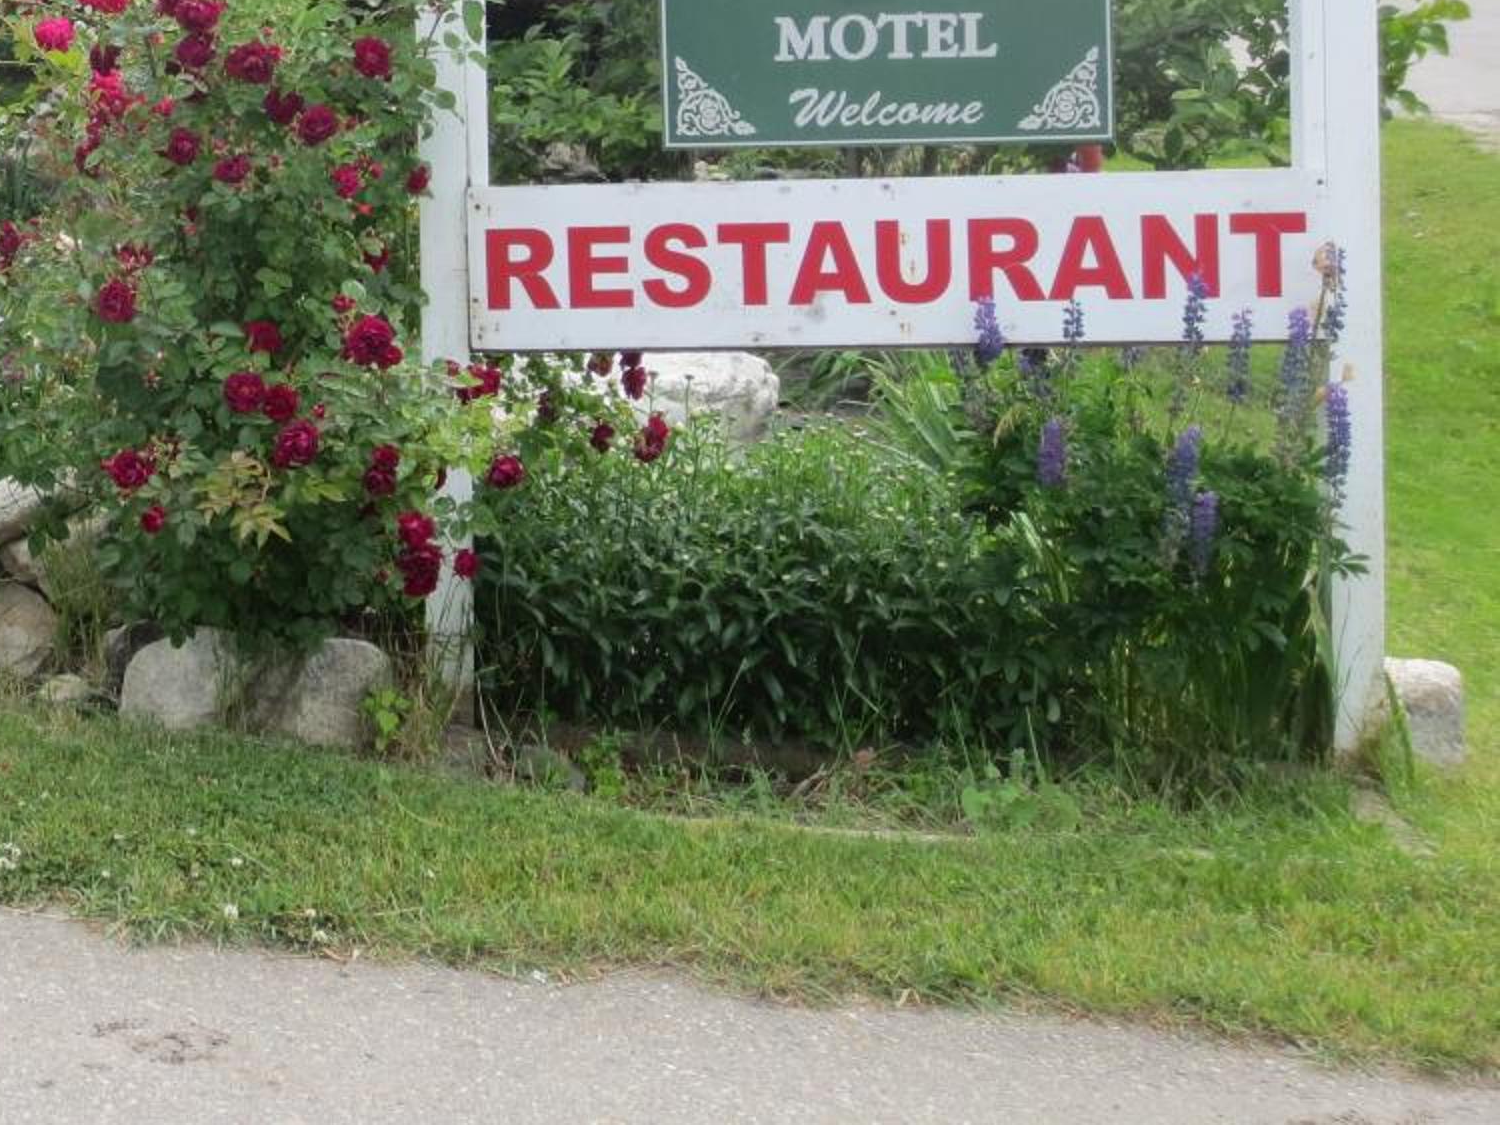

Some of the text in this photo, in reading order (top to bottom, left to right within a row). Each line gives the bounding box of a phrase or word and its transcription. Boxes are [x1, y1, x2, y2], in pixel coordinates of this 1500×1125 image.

[773, 11, 998, 63] MOTEL
[788, 87, 984, 128] Welcome
[484, 211, 1307, 311] RESTAURANT
